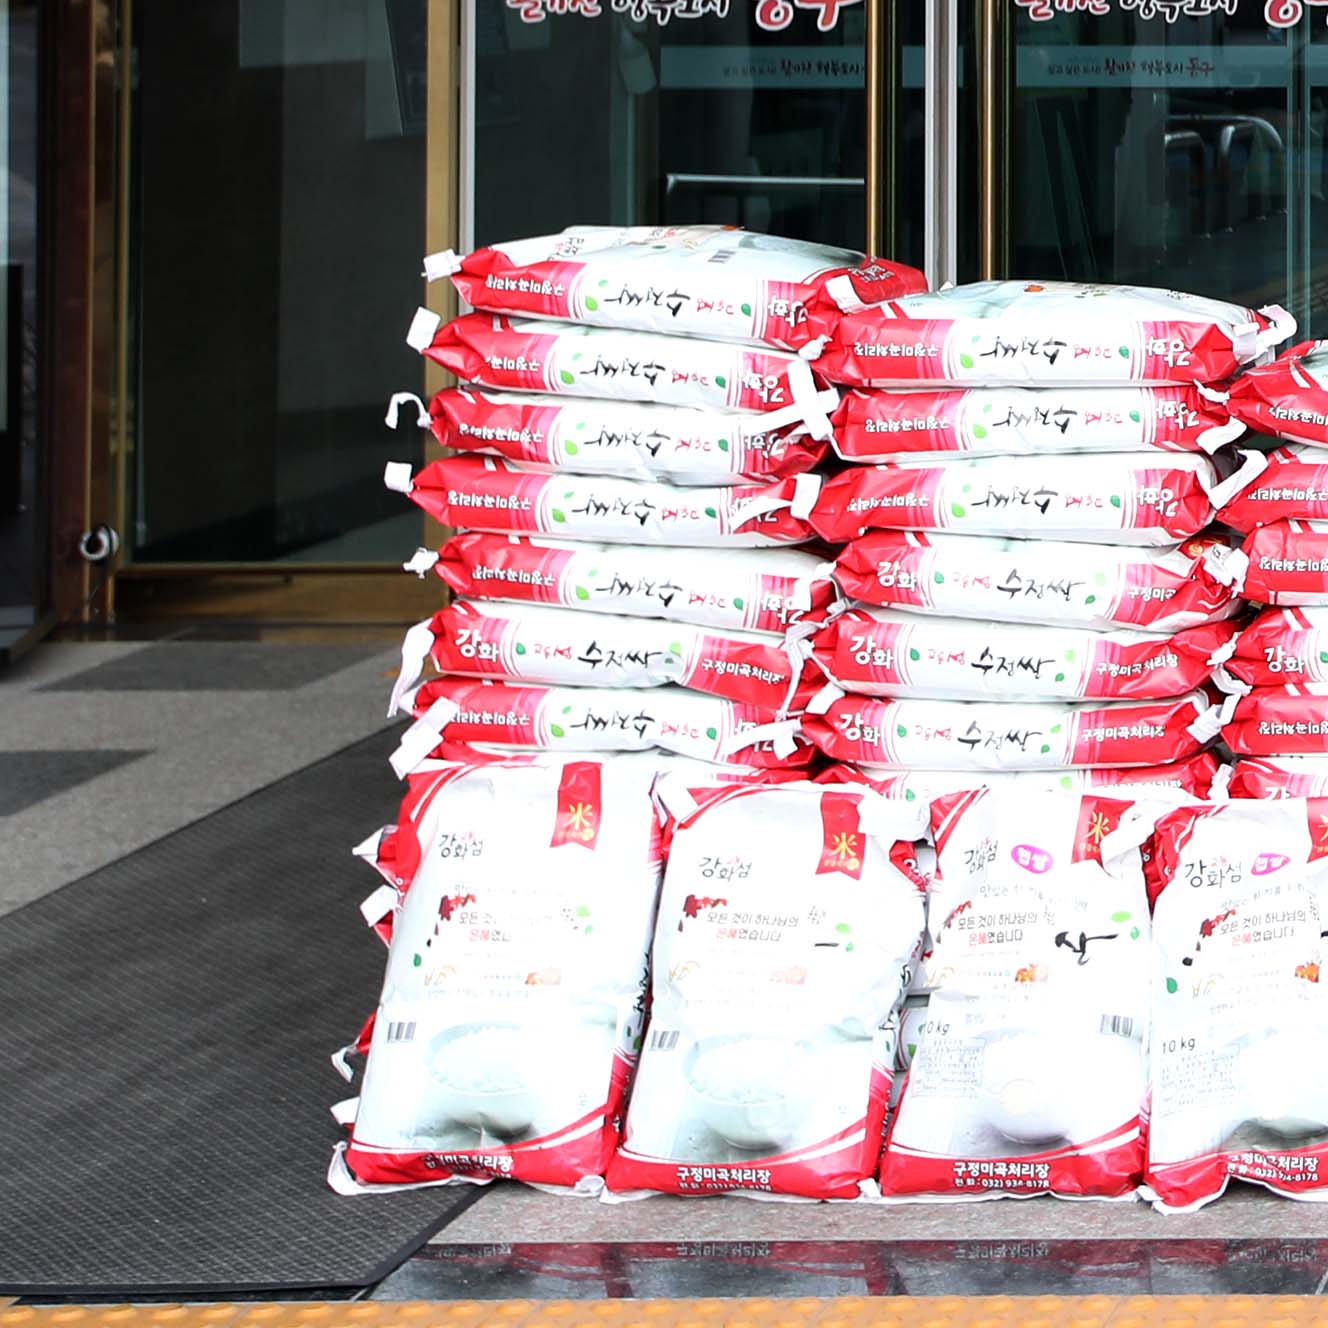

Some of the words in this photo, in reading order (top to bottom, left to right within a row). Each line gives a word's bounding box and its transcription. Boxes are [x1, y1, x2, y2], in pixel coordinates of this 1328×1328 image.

[605, 285, 691, 318] 수정쌀
[981, 336, 1068, 365] 수정쌀
[571, 494, 657, 526] 수정쌀
[456, 630, 500, 663] 강화
[579, 640, 663, 670] 수정쌀
[850, 635, 894, 670] 강화
[970, 646, 1056, 677] 수정쌀
[1264, 646, 1304, 674] 강화
[841, 713, 880, 745] 강화
[957, 721, 1042, 751] 수정쌀
[438, 833, 484, 859] 강화섬
[699, 856, 753, 883] 강화섬
[1184, 857, 1243, 889] 강화섬
[678, 1165, 771, 1184] 구정미곡처리장
[953, 1160, 1050, 1178] 구정미곡처리장
